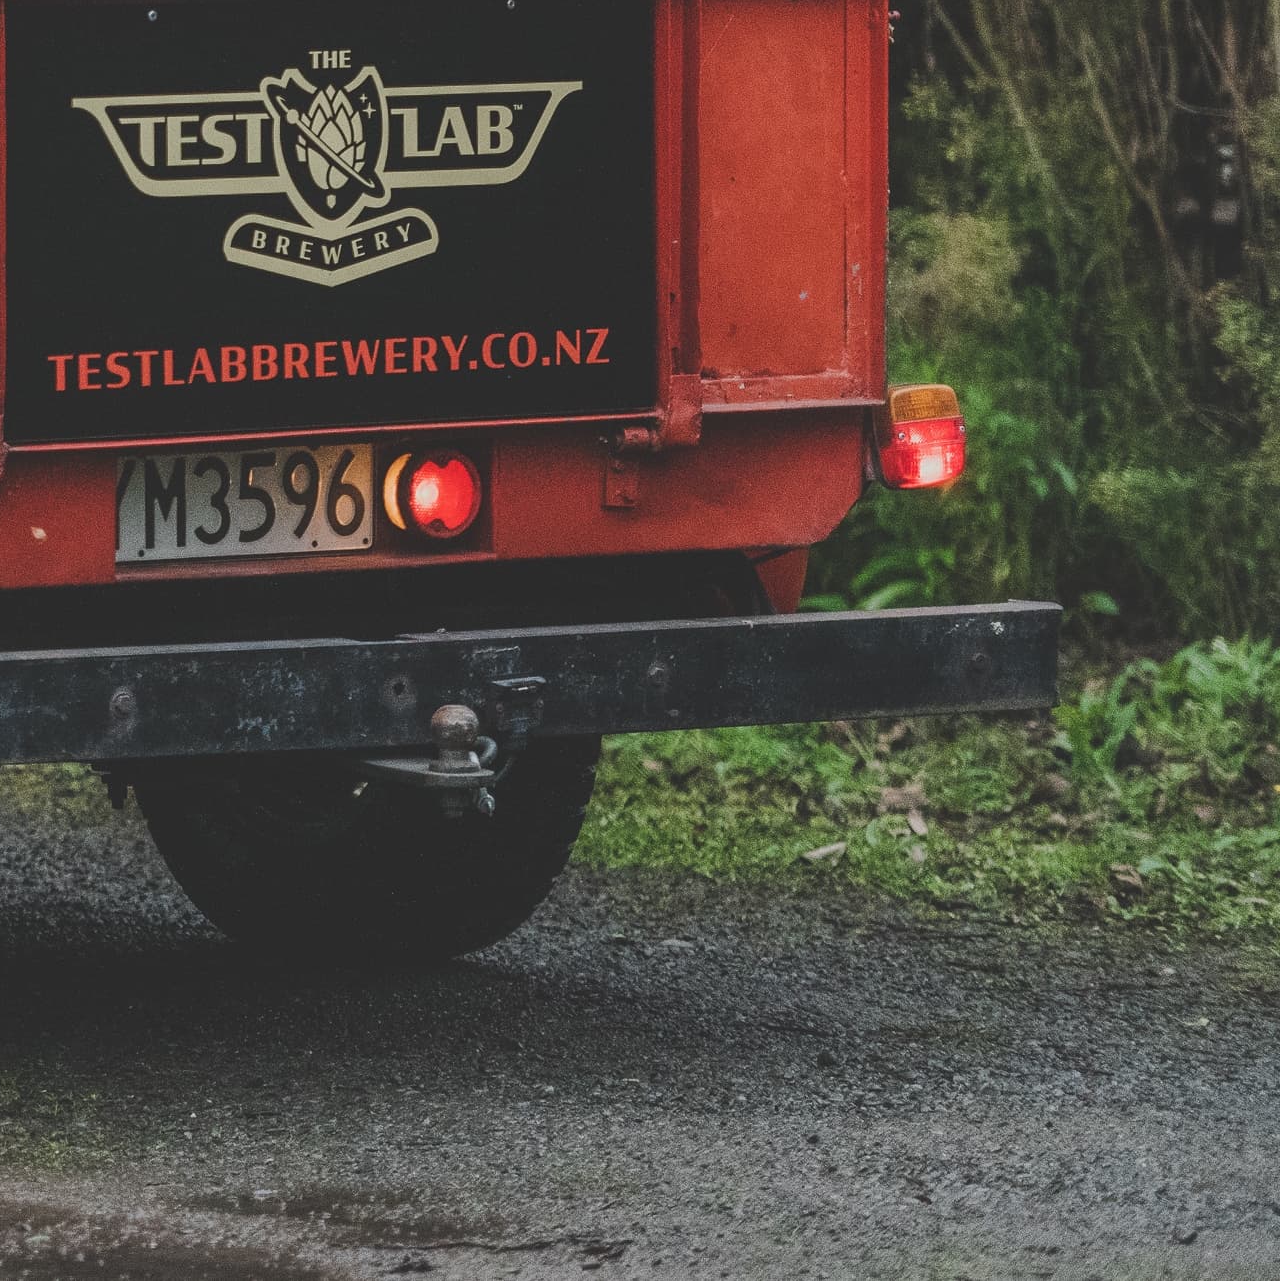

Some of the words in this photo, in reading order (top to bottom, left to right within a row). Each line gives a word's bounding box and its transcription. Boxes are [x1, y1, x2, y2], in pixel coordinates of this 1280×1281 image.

[308, 49, 352, 70] THE
[118, 112, 273, 167] TEST
[390, 105, 515, 159] LAB
[251, 222, 414, 266] BREWERY
[47, 327, 611, 393] TESTLABBREWERY.CO.NZ
